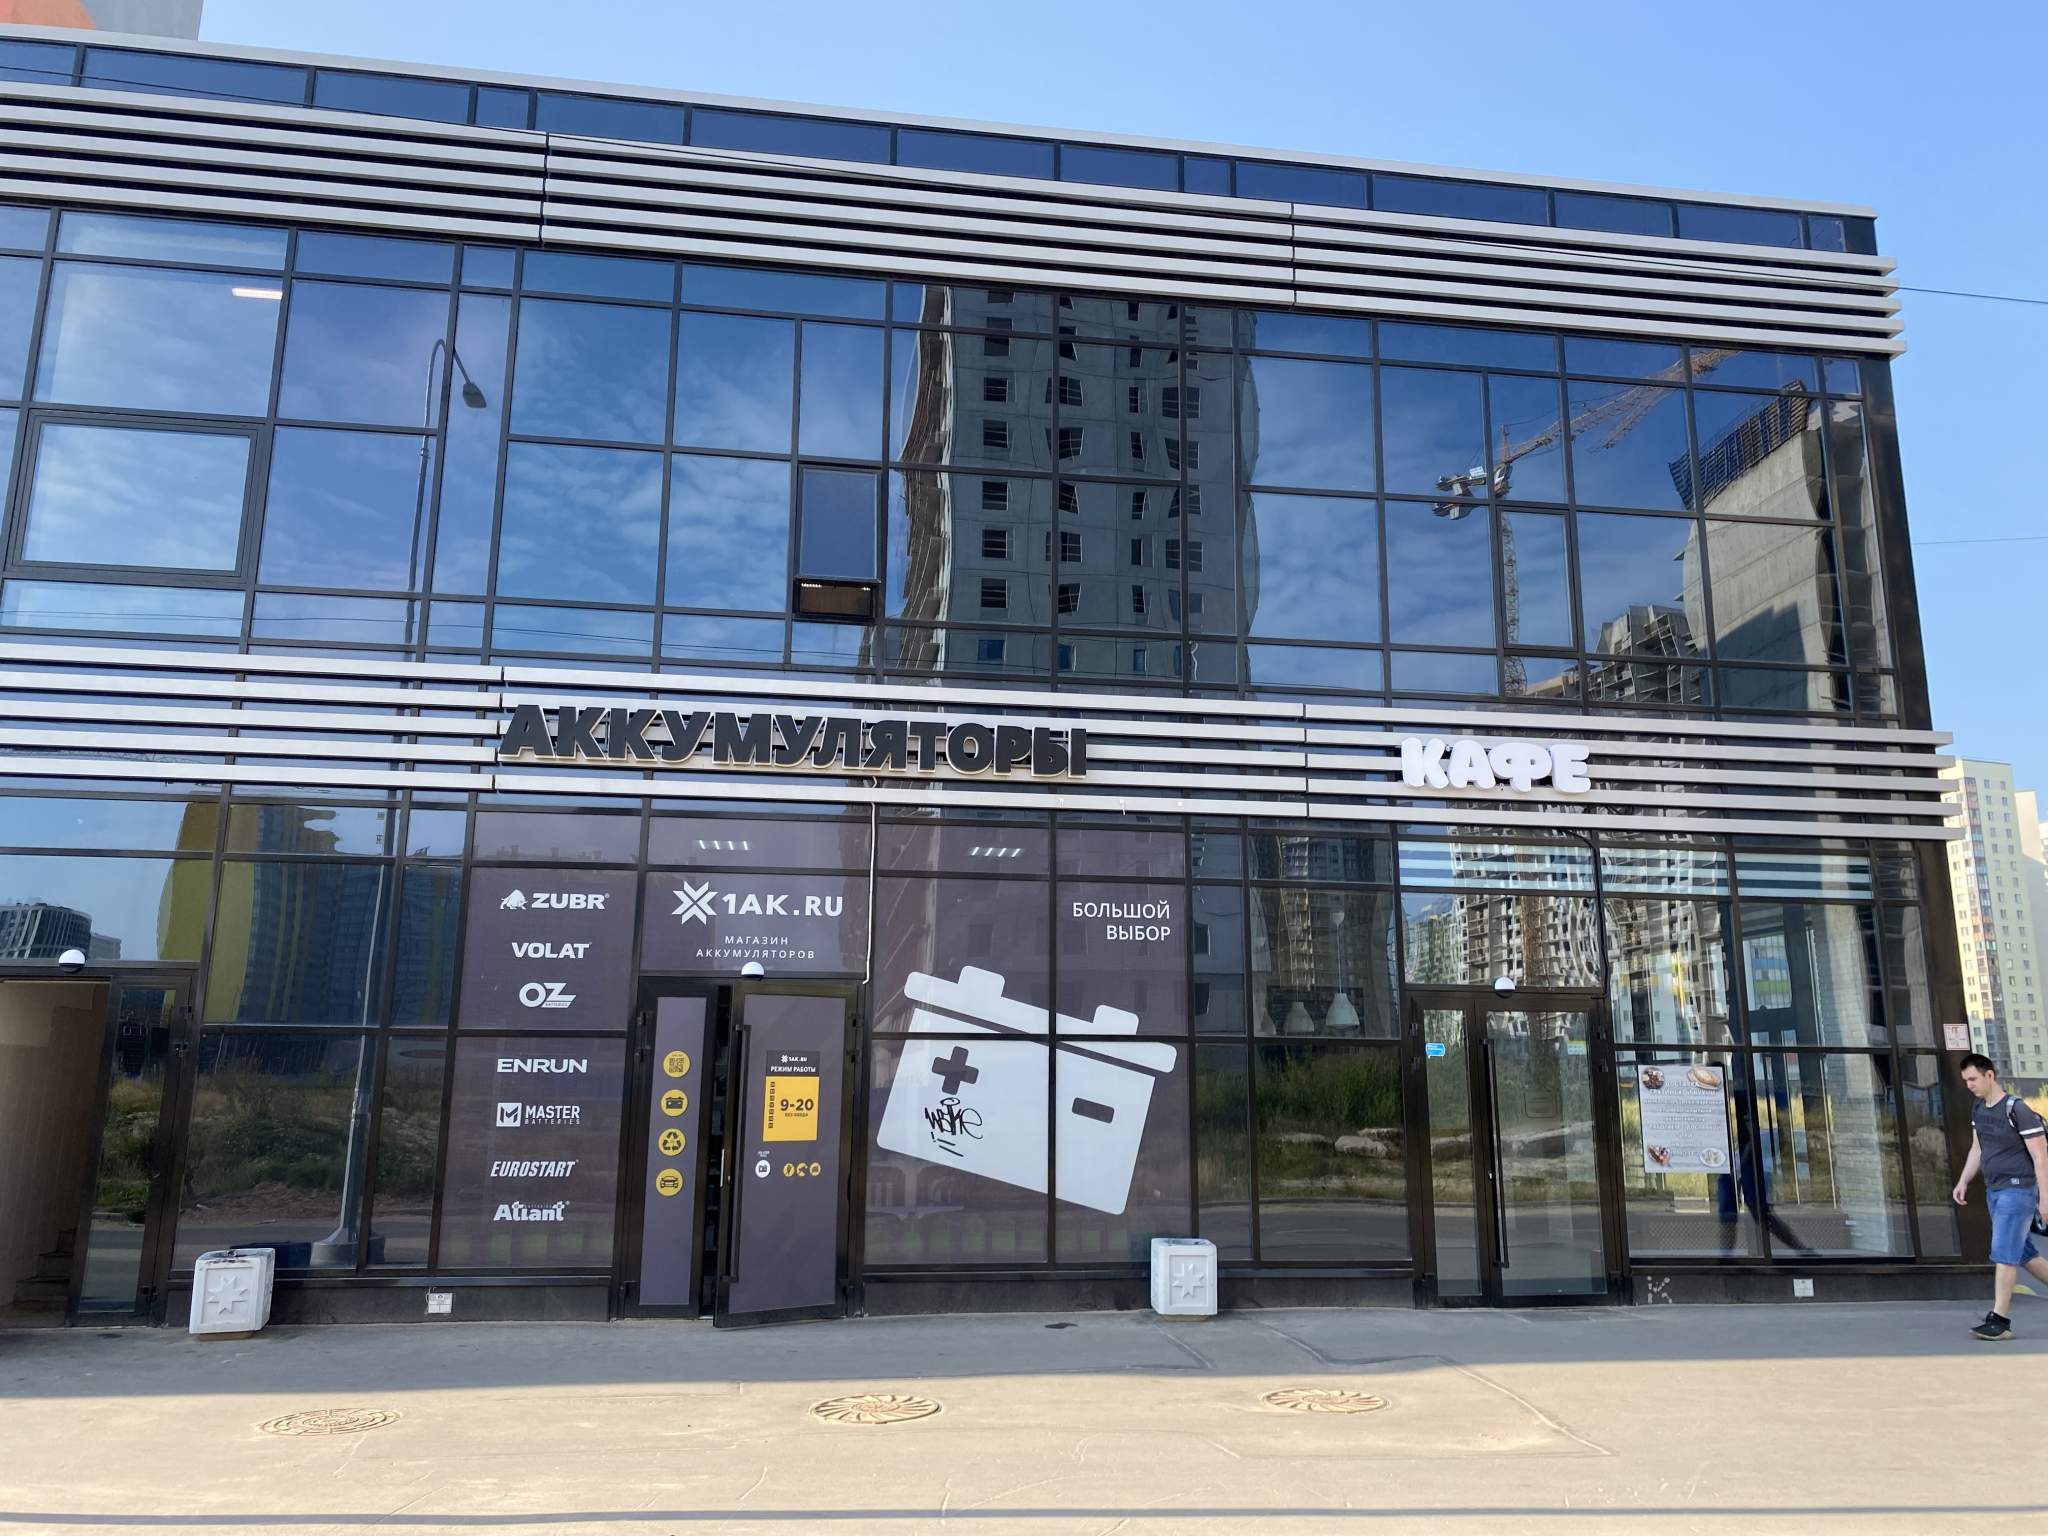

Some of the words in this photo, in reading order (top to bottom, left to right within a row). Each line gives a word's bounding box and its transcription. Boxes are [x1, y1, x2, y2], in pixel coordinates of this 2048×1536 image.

[498, 704, 1088, 779] АККУМУЛЯТОРЫ
[1401, 737, 1592, 793] КАФЕ
[531, 893, 606, 910] ZUBR
[722, 893, 843, 917] 1AK.RU
[1073, 900, 1170, 920] БОЛЬШОЙ
[724, 935, 789, 945] МАГАЗИН
[1106, 925, 1171, 941] ВЫБОР
[511, 942, 590, 959] VOLAT
[696, 948, 815, 959] АККУМУЛЯТОРОВ
[518, 982, 577, 1008] OZ
[497, 1058, 588, 1073] ENRUN
[525, 1105, 581, 1119] MASTER
[780, 1099, 814, 1111] 9-20
[490, 1161, 576, 1177] EUROSTART
